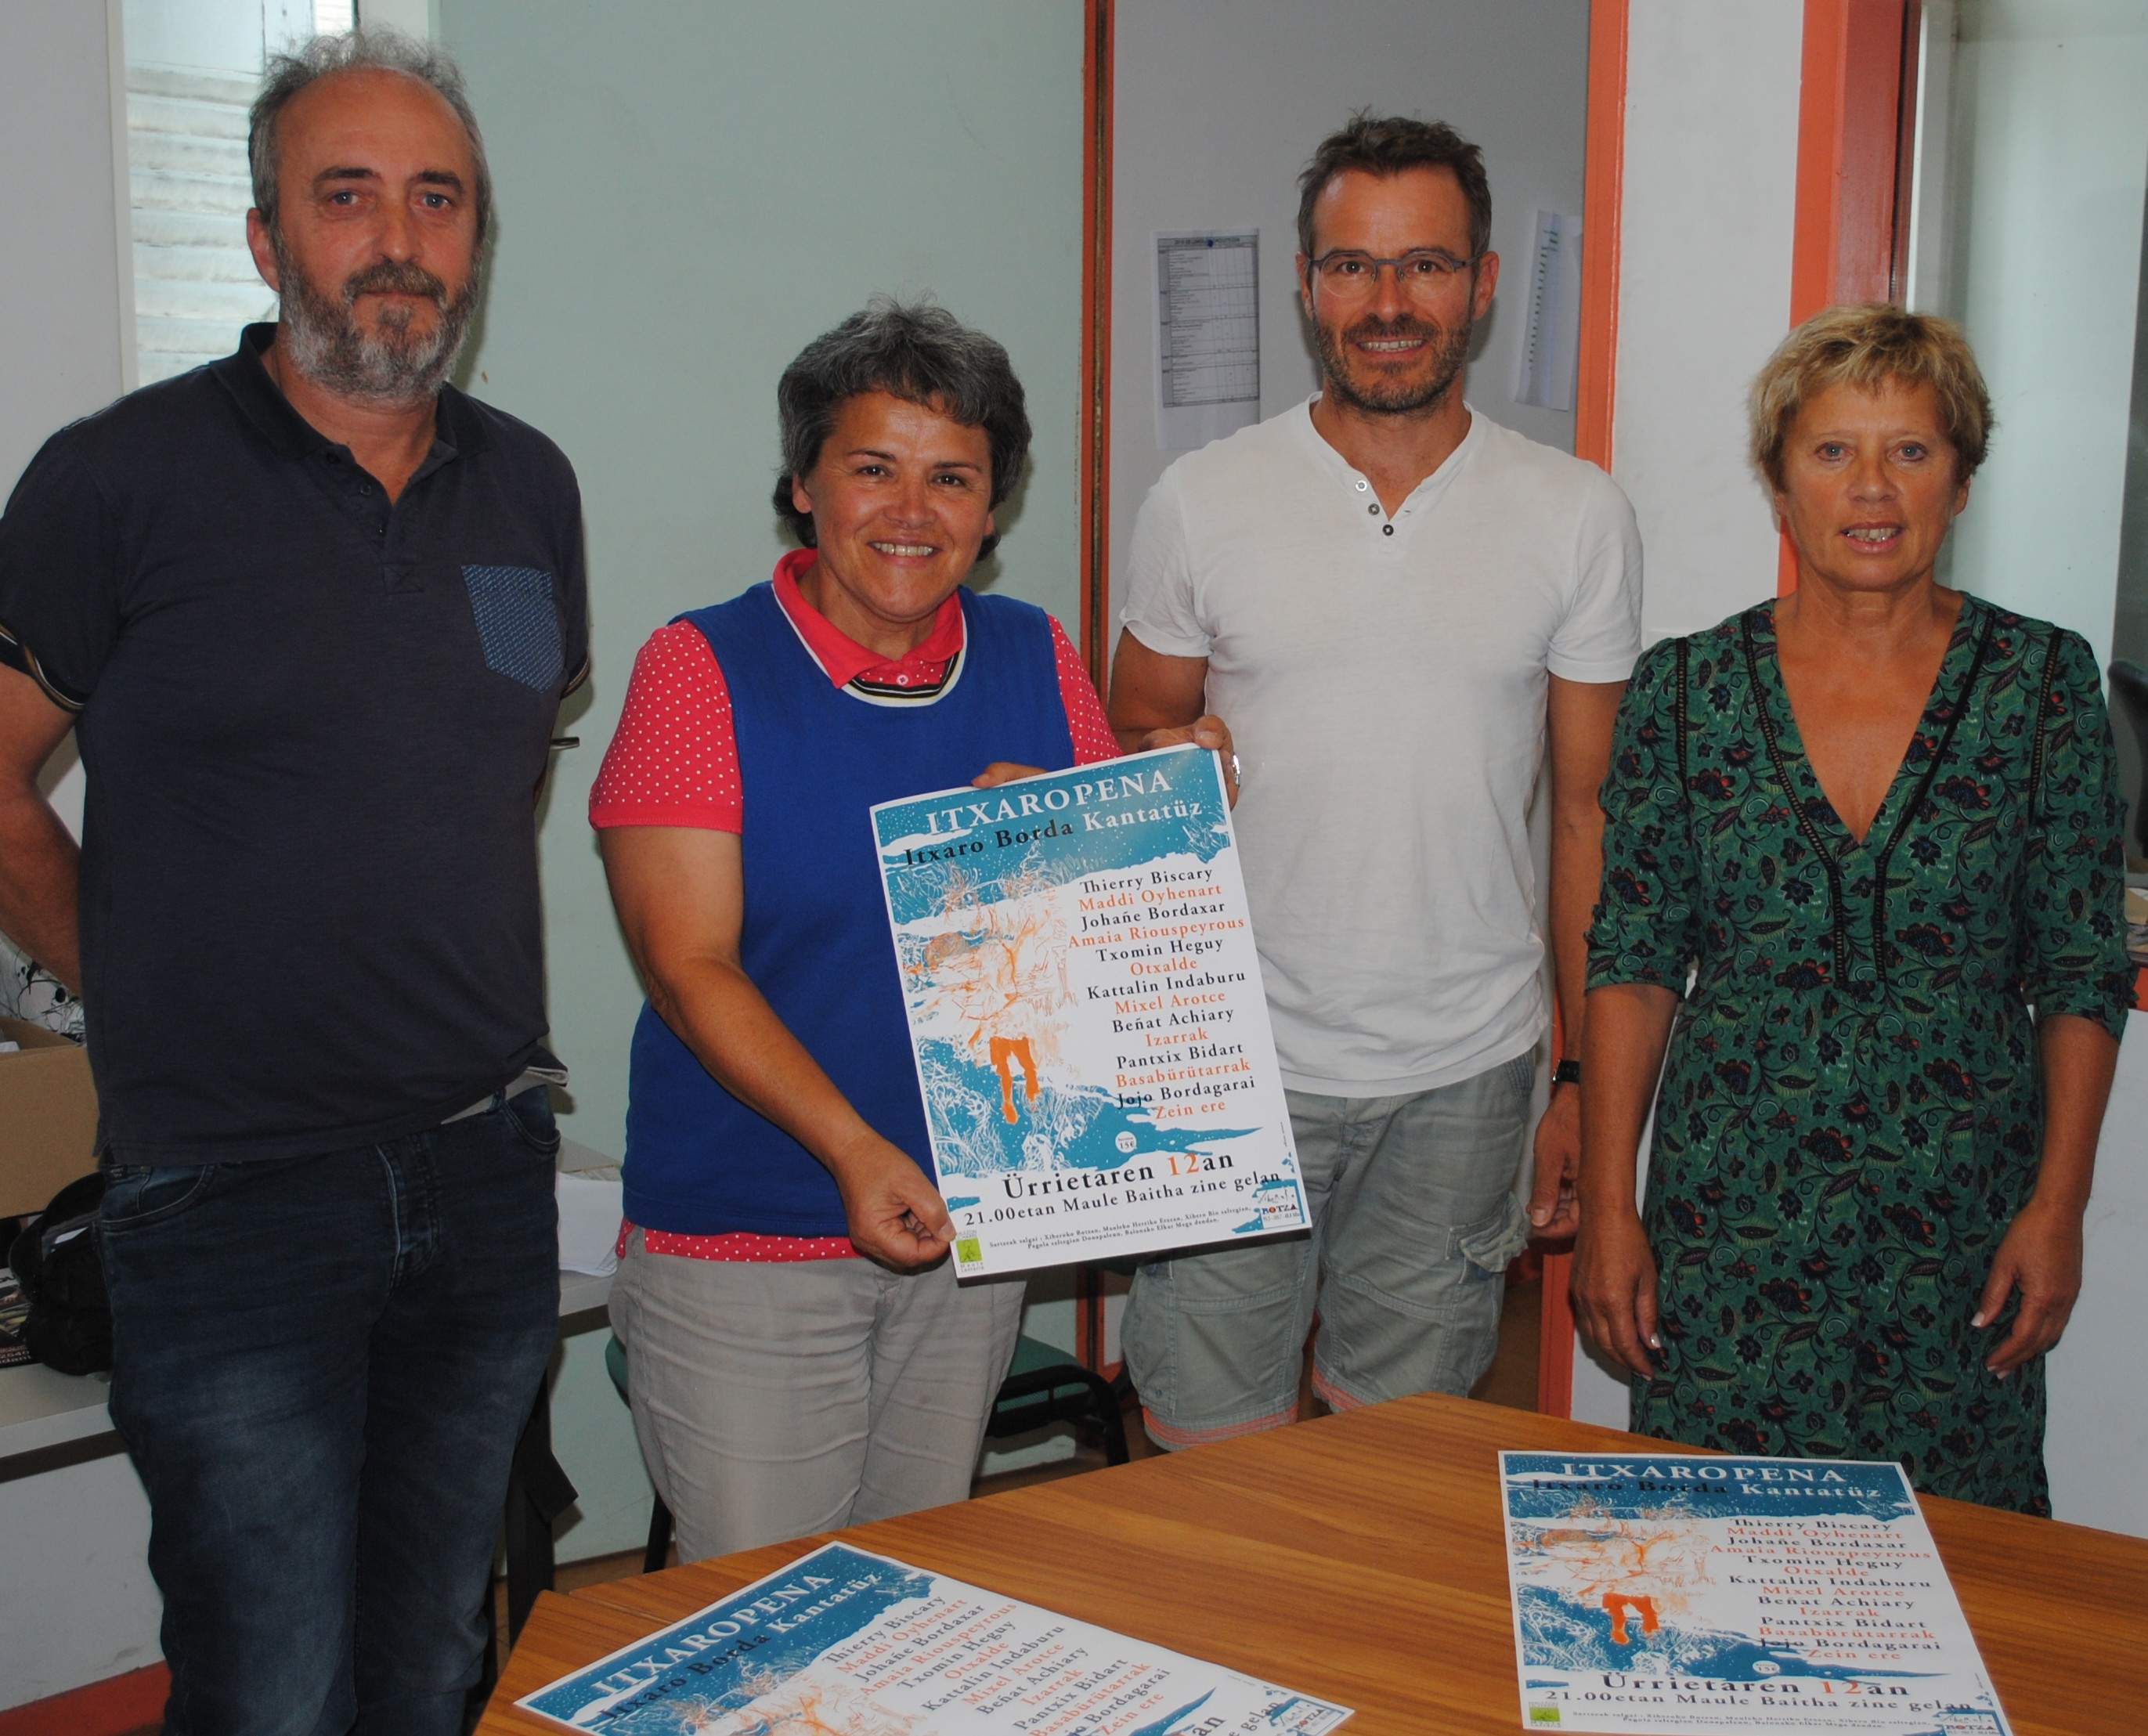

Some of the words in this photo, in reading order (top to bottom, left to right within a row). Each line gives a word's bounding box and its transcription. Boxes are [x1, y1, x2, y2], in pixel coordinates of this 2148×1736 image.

[926, 769, 1173, 836] ITXAROPENA
[904, 840, 984, 865] Itxaro
[995, 819, 1074, 849] Borda
[1085, 800, 1202, 832] Kantatüz
[1079, 879, 1143, 894] Thierry
[1150, 869, 1213, 885] Biscary
[1078, 892, 1135, 912] Maddi
[1141, 884, 1222, 905] Oyhenart
[1081, 911, 1142, 933] Johañe
[1148, 901, 1226, 921] Bordaxar
[1068, 931, 1123, 949] Amaia
[1128, 917, 1246, 940] Riouspeyrous
[1096, 944, 1164, 962] Txomin
[1169, 939, 1224, 955] Heguy
[1129, 956, 1198, 976] Otxalde
[1087, 980, 1160, 1000] Kattalin
[1166, 971, 1247, 990] Indaburu
[1114, 995, 1164, 1016] Mixel
[1170, 991, 1226, 1008] Arotce
[1111, 1017, 1162, 1034] Beñat
[1168, 1008, 1234, 1027] Achiary
[1145, 1027, 1210, 1047] Izarrak
[1116, 1050, 1182, 1070] Pantxix
[1188, 1042, 1244, 1061] Bidart
[1115, 1057, 1251, 1089] Basabürütarrak
[1117, 1090, 1153, 1110] Jojo
[1160, 1075, 1256, 1102] Bordagarai
[1155, 1103, 1194, 1121] Zein
[1200, 1101, 1226, 1113] ere
[1002, 1165, 1155, 1200] Ürrietaren
[1168, 1153, 1235, 1177] 12an
[963, 1204, 1056, 1226] 21.00etan
[1062, 1193, 1119, 1213] Maule
[1126, 1182, 1185, 1204] Baitha
[1190, 1178, 1228, 1194] zine
[1233, 1171, 1282, 1192] gelan
[1561, 1463, 1847, 1482] ITXAROPENA
[1533, 1479, 1623, 1491] Itxaro
[1637, 1481, 1727, 1493] Borda
[1740, 1483, 1882, 1498] Kantatüz
[1727, 1527, 1793, 1537] Maddi
[1802, 1528, 1904, 1540] Oyhenart
[1731, 1518, 1806, 1530] Thierry
[1816, 1521, 1893, 1532] Biscary
[1710, 1545, 1776, 1554] Amaia
[1785, 1547, 1933, 1560] Riouspeyrous
[1727, 1536, 1802, 1547] Johañe
[1810, 1539, 1908, 1550] Bordaxar
[1742, 1554, 1825, 1565] Txomin
[1836, 1557, 1904, 1569] Heguy
[1782, 1566, 1870, 1577] Otxalde
[1728, 1575, 1825, 1586] Kattalin
[1829, 1577, 1933, 1589] Indaburu
[1762, 1586, 1823, 1596] Mixel
[1833, 1587, 1906, 1597] Arotce
[1758, 1596, 1821, 1605] Beñat
[1830, 1597, 1915, 1610] Achiary
[1800, 1607, 1880, 1617] Izarrak
[591, 1572, 834, 1696] ITXAROPENA
[822, 1629, 887, 1665] Thierry
[883, 1595, 947, 1630] Biscary
[836, 1641, 893, 1674] Maddi
[891, 1598, 969, 1642] Oyhenart
[1760, 1615, 1845, 1627] Pantxix
[1854, 1618, 1928, 1629] Bidart
[599, 1676, 688, 1720] Itxaro
[685, 1633, 772, 1676] Borda
[765, 1571, 883, 1633] Kantatüz
[854, 1646, 915, 1684] Johañe
[911, 1604, 986, 1648] Bordaxar
[859, 1665, 915, 1697] Amaia
[910, 1603, 1018, 1665] Riouspeyrous
[897, 1651, 965, 1690] Txomin
[962, 1620, 1016, 1652] Heguy
[1807, 1648, 1858, 1659] Zein
[1868, 1651, 1903, 1660] ere
[1815, 1638, 1943, 1651] Bordagarai
[921, 1669, 994, 1712] Kattalin
[989, 1625, 1066, 1670] Indaburu
[944, 1641, 1009, 1680] Otxalde
[961, 1674, 1014, 1706] Mixel
[1011, 1642, 1065, 1676] Arotce
[975, 1684, 1028, 1715] Beñat
[1026, 1647, 1089, 1686] Achiary
[1013, 1691, 1078, 1731] Pantxix
[1073, 1658, 1128, 1691] Bidart
[1020, 1667, 1085, 1706] Izarrak
[1600, 1672, 1800, 1693] Ürrietaren
[1821, 1680, 1911, 1696] 12an
[1083, 1667, 1172, 1724] Bordagarai
[1546, 1690, 1665, 1702] 21.00etan
[1676, 1693, 1750, 1705] Maule
[1760, 1695, 1839, 1708] Baitha
[1848, 1698, 1899, 1709] zine
[1908, 1699, 1972, 1713] gelan
[1099, 1708, 1139, 1736] Zein
[1139, 1692, 1165, 1710] ere
